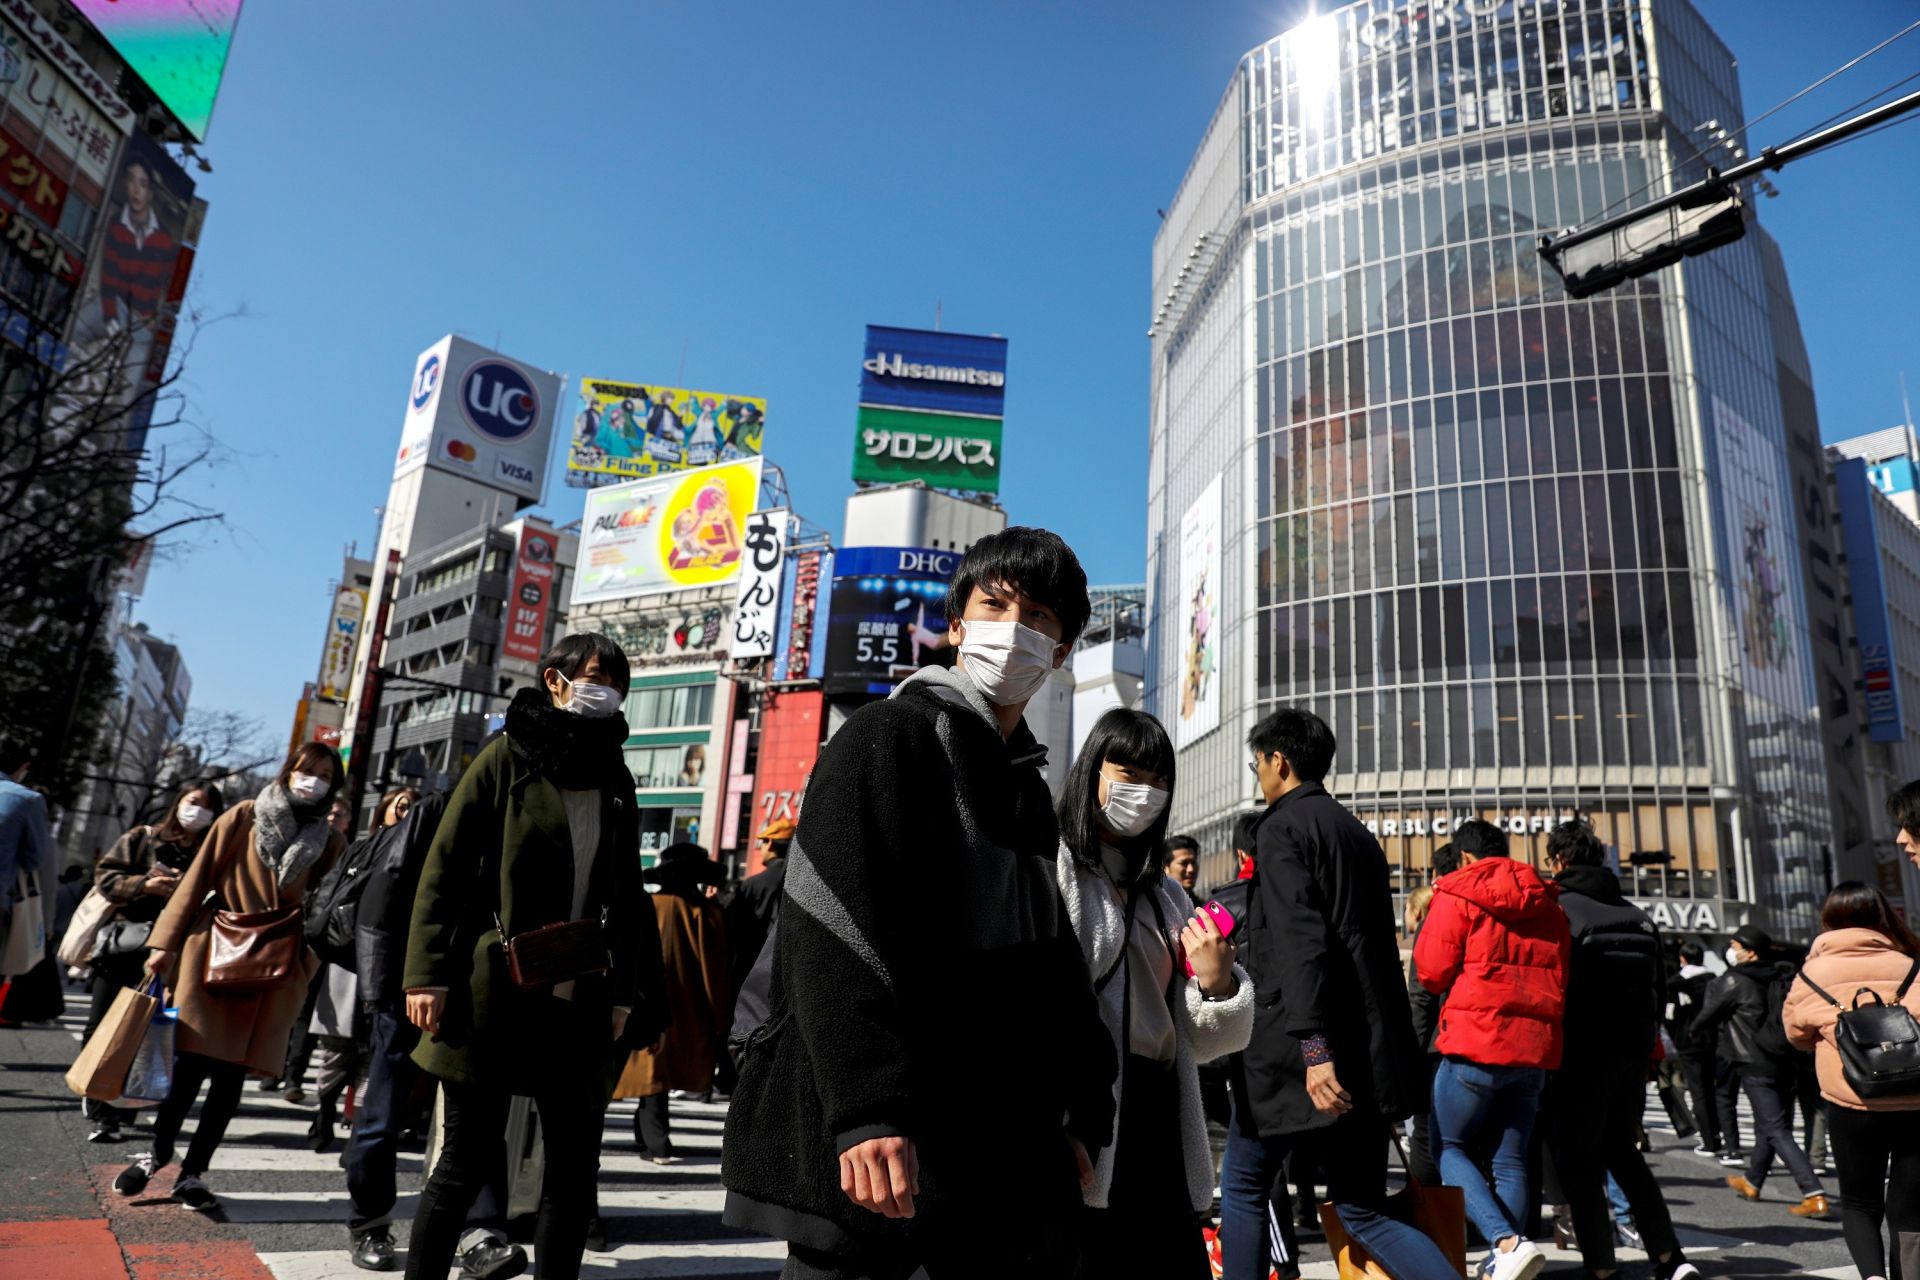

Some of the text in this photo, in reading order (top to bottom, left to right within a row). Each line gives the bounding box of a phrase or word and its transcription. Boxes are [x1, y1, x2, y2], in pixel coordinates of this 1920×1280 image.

[863, 352, 1004, 387] Hisamitsu
[469, 373, 533, 426] UC
[862, 427, 995, 467] サロンパス
[501, 461, 534, 483] VISA
[605, 457, 652, 474] Fling
[898, 551, 953, 575] DHC
[735, 513, 780, 652] もんじゃ
[856, 637, 899, 662] 5.5
